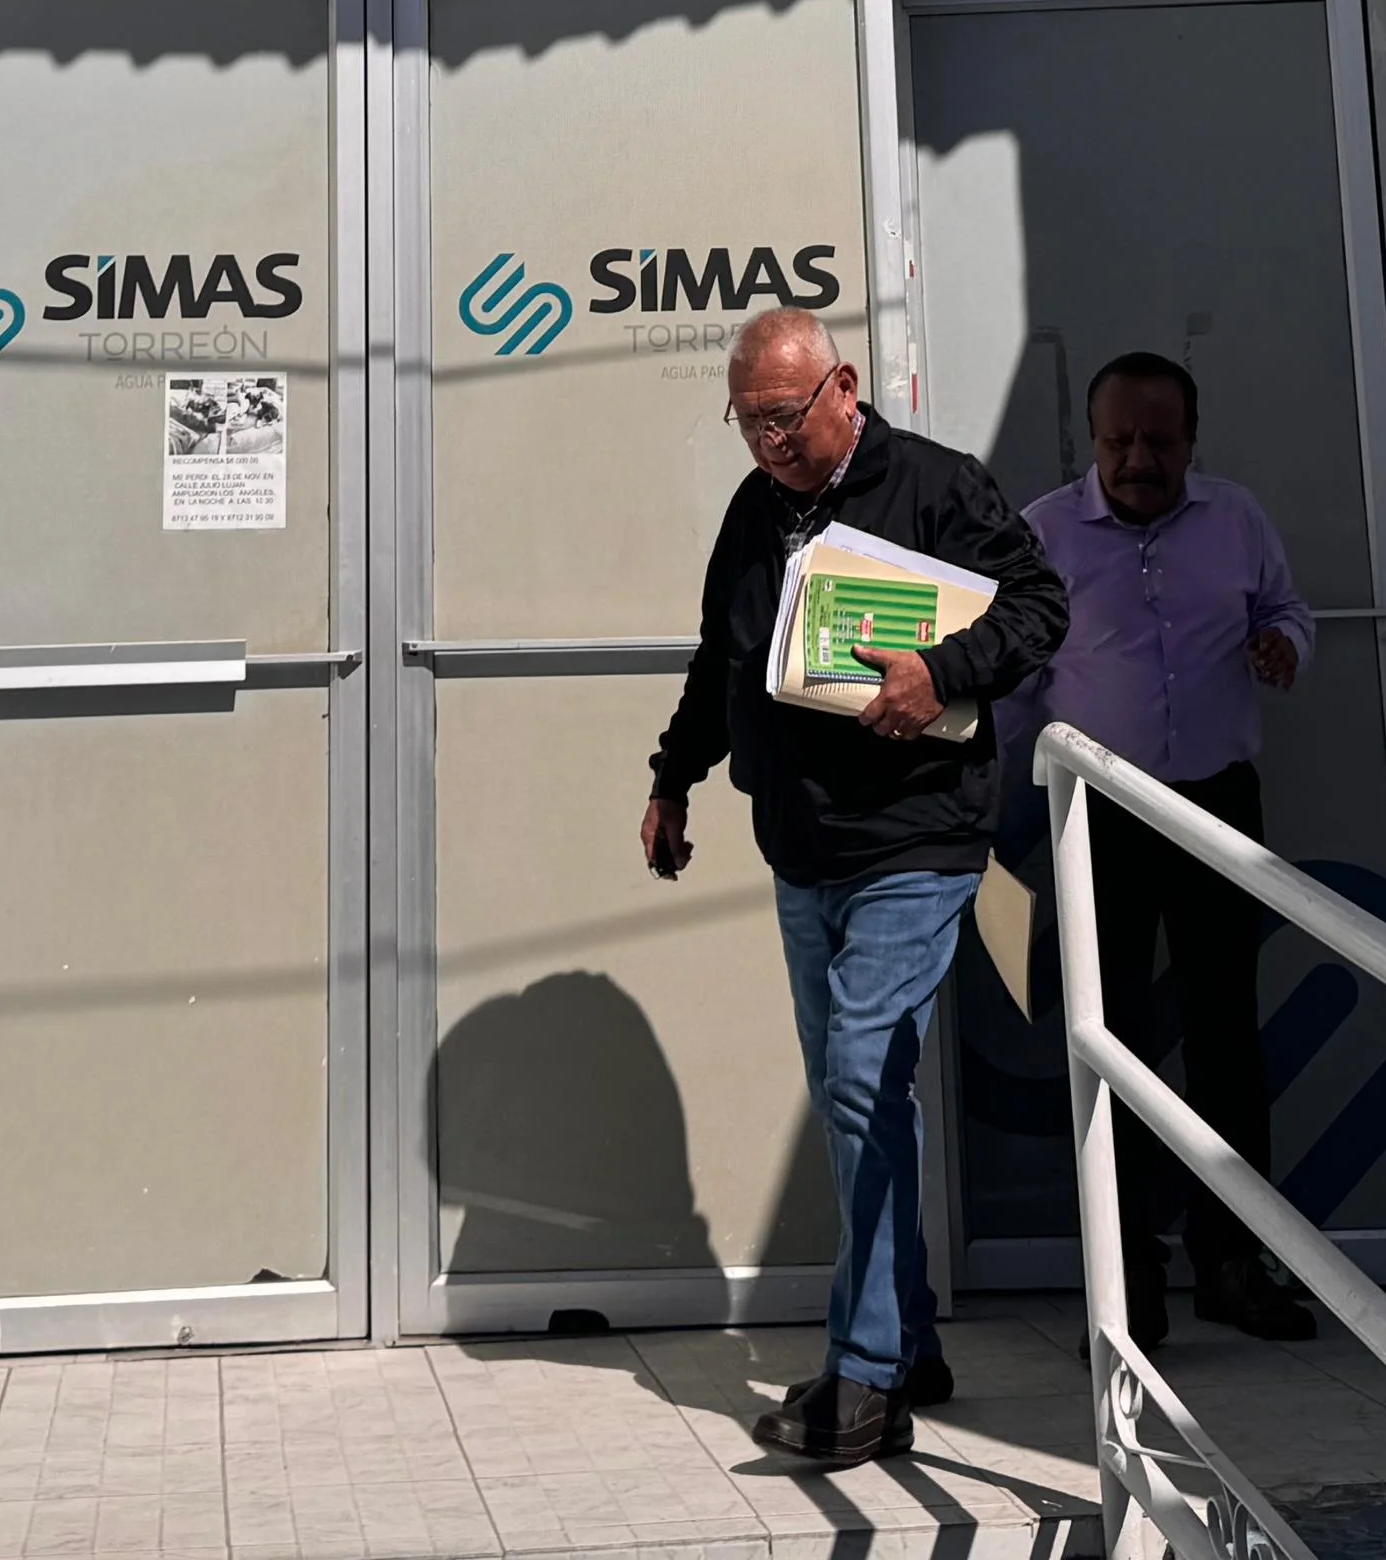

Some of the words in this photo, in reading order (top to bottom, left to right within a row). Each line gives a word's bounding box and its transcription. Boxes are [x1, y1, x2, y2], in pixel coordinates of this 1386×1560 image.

[78, 324, 269, 362] TORREÓN
[623, 323, 745, 353] TORR
[115, 374, 154, 390] AGUA
[660, 366, 698, 380] AGUA
[700, 365, 726, 379] PAR
